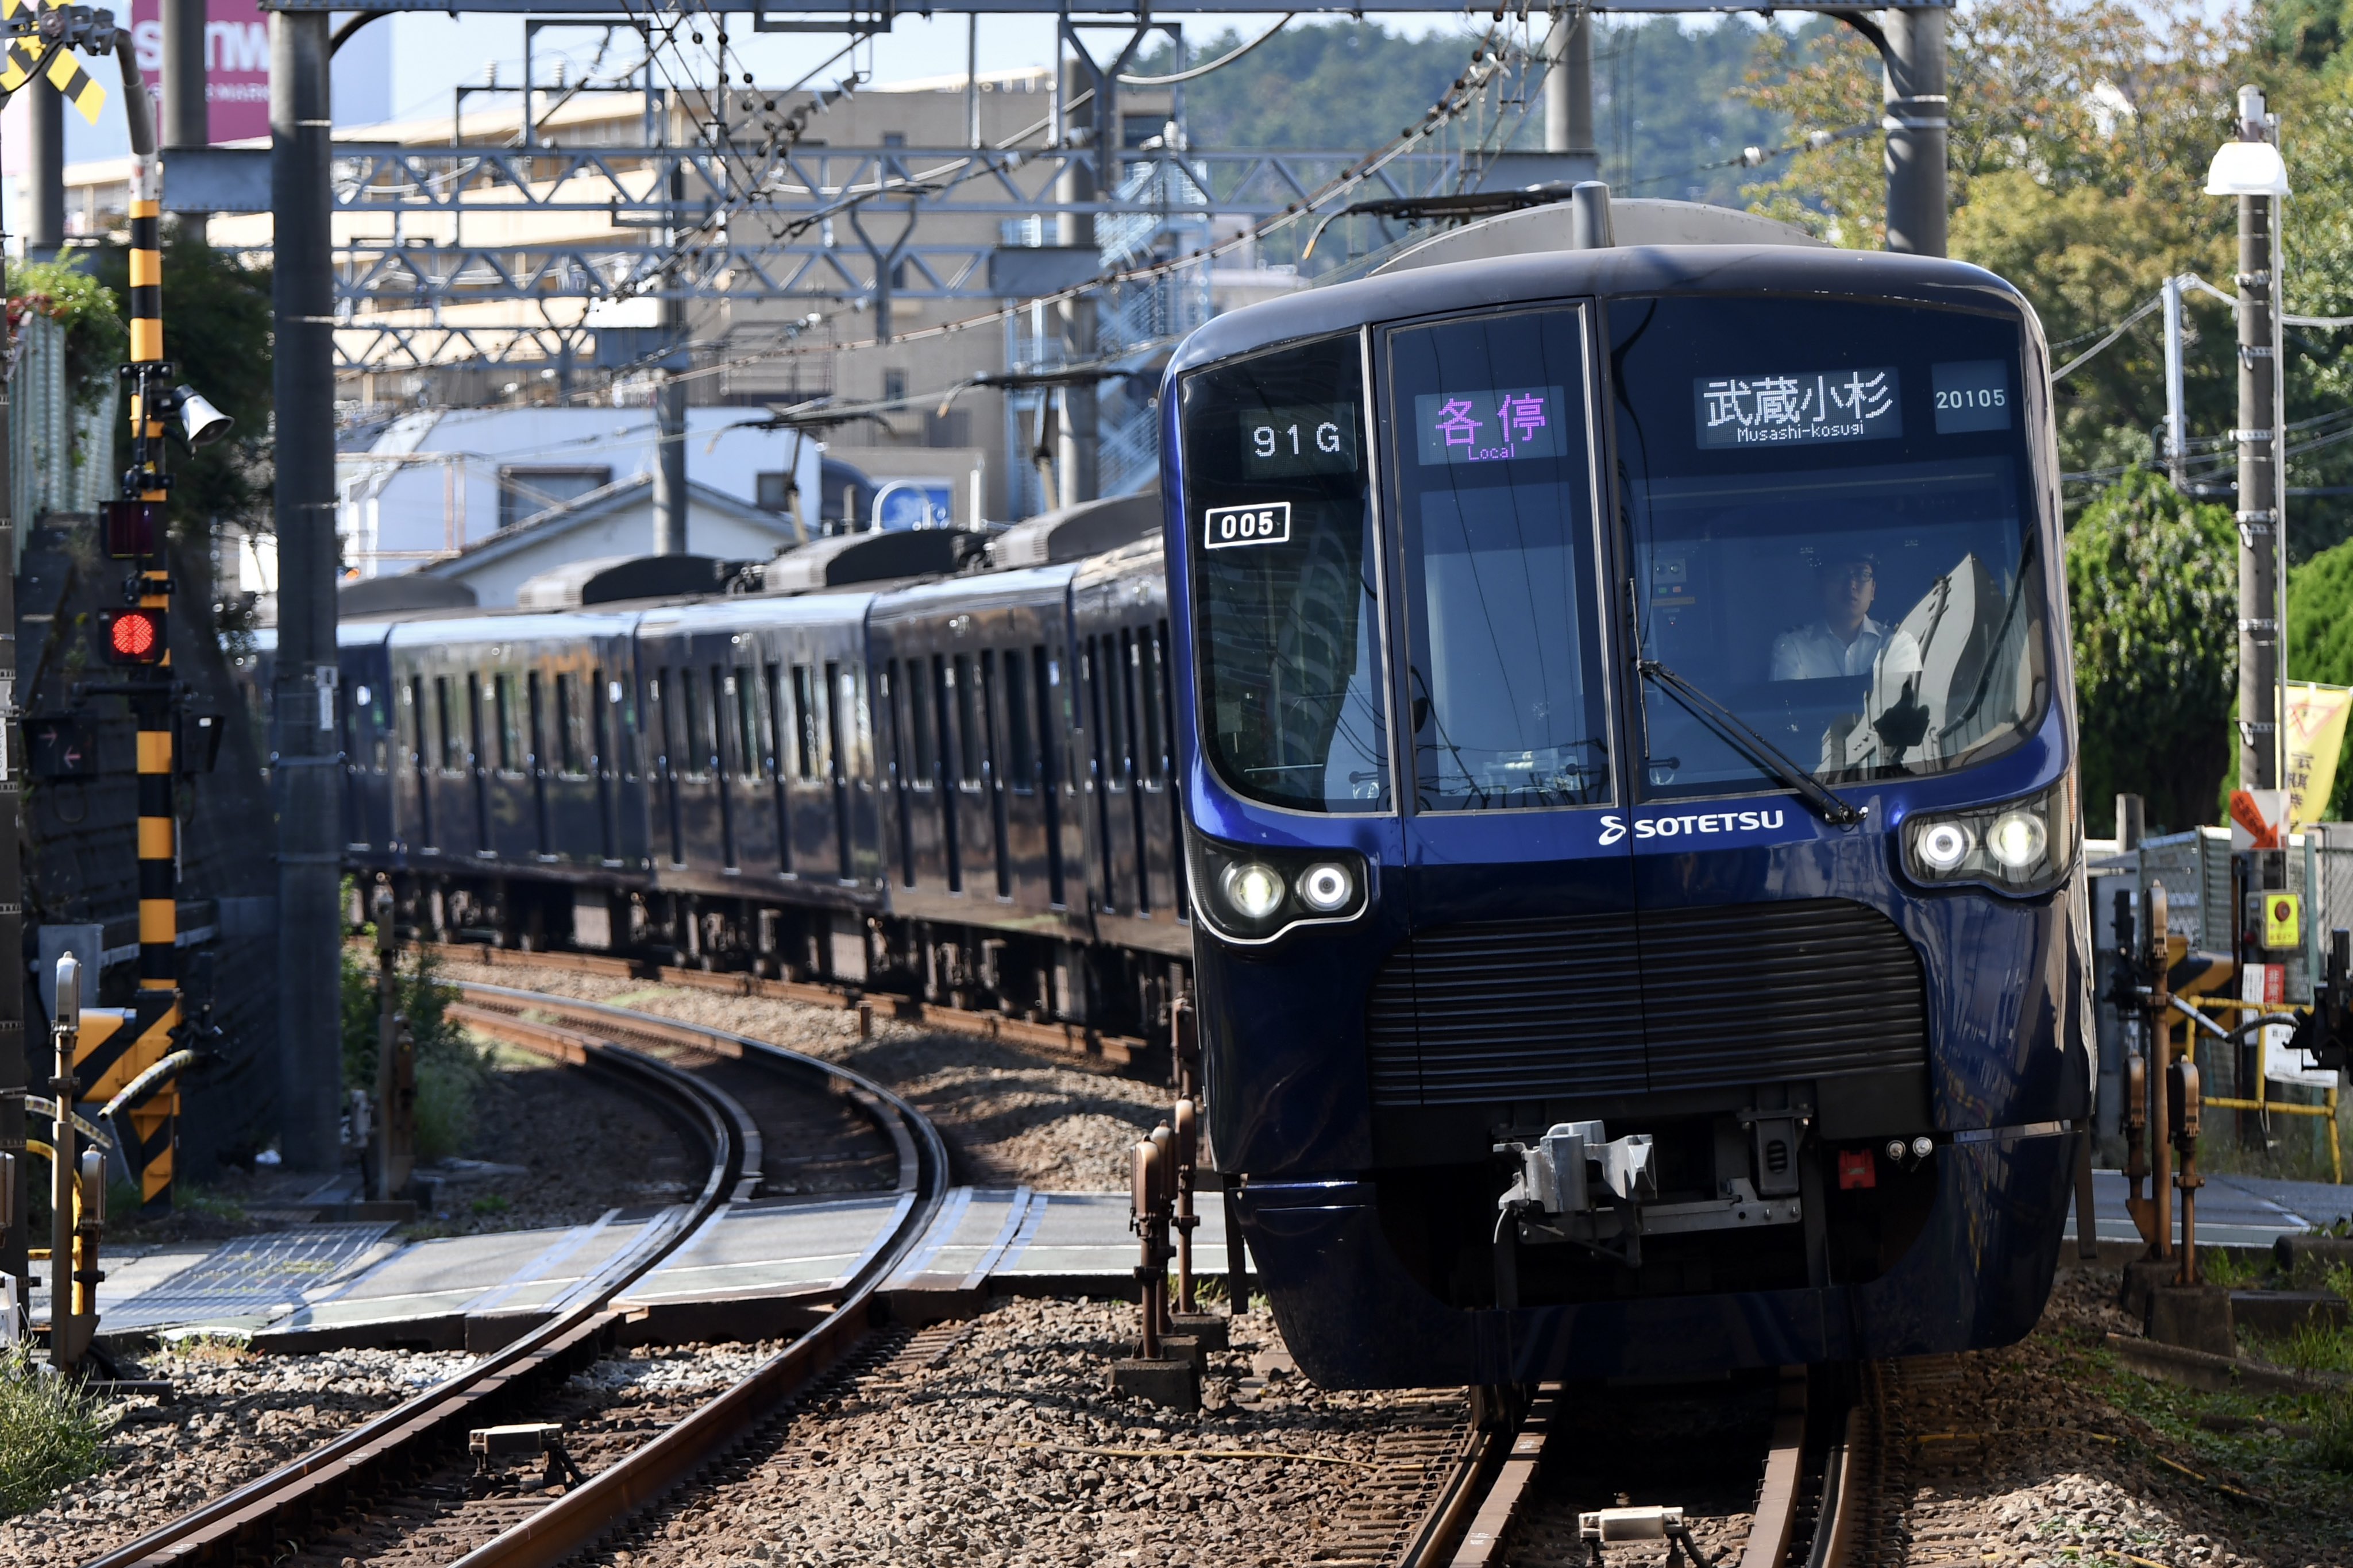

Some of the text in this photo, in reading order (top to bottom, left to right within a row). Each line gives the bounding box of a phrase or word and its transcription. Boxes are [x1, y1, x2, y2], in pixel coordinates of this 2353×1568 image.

[1704, 372, 1892, 426] 武蔵小杉
[1936, 389, 2005, 409] 20105
[1436, 393, 1546, 446] 各停
[1737, 420, 1864, 442] Musashi-kosugi
[1468, 443, 1515, 461] Local
[1221, 512, 1274, 539] 005
[1634, 810, 1784, 838] SOTETSU
